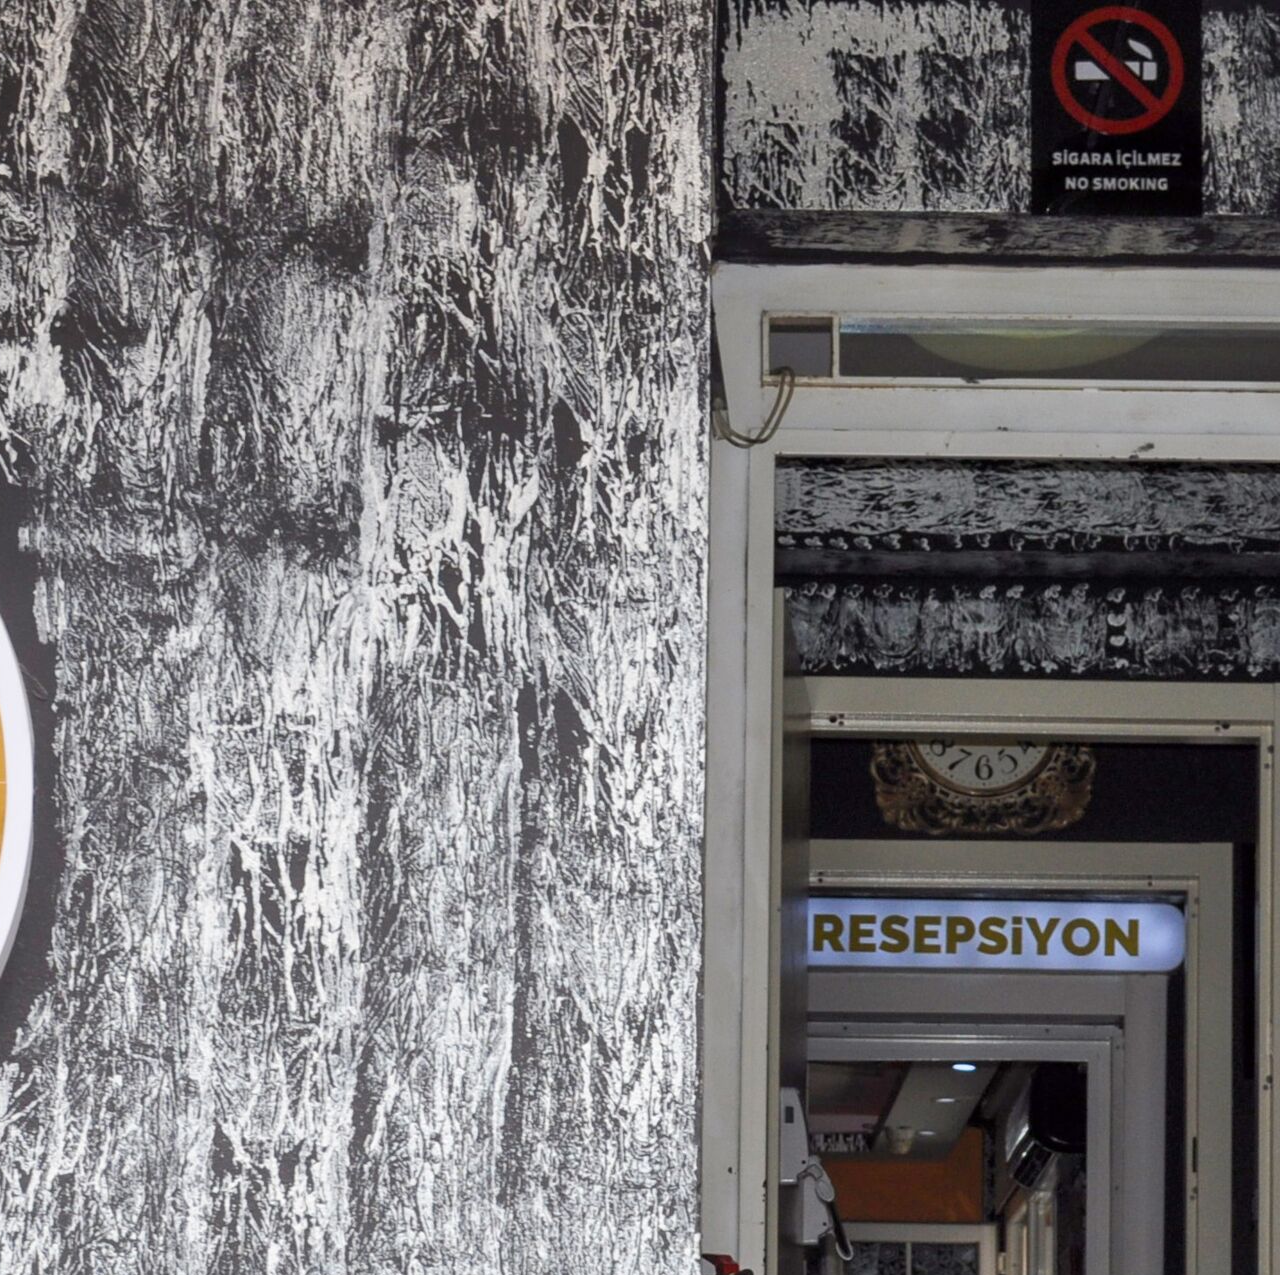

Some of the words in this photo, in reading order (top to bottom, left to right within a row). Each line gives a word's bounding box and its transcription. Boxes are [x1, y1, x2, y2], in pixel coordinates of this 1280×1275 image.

[1052, 149, 1114, 166] SİGARA
[1116, 149, 1182, 169] İÇİLMEZ
[1065, 177, 1089, 190] NO
[1092, 177, 1169, 191] SMOKING
[974, 754, 994, 781] 6
[998, 748, 1019, 774] 5
